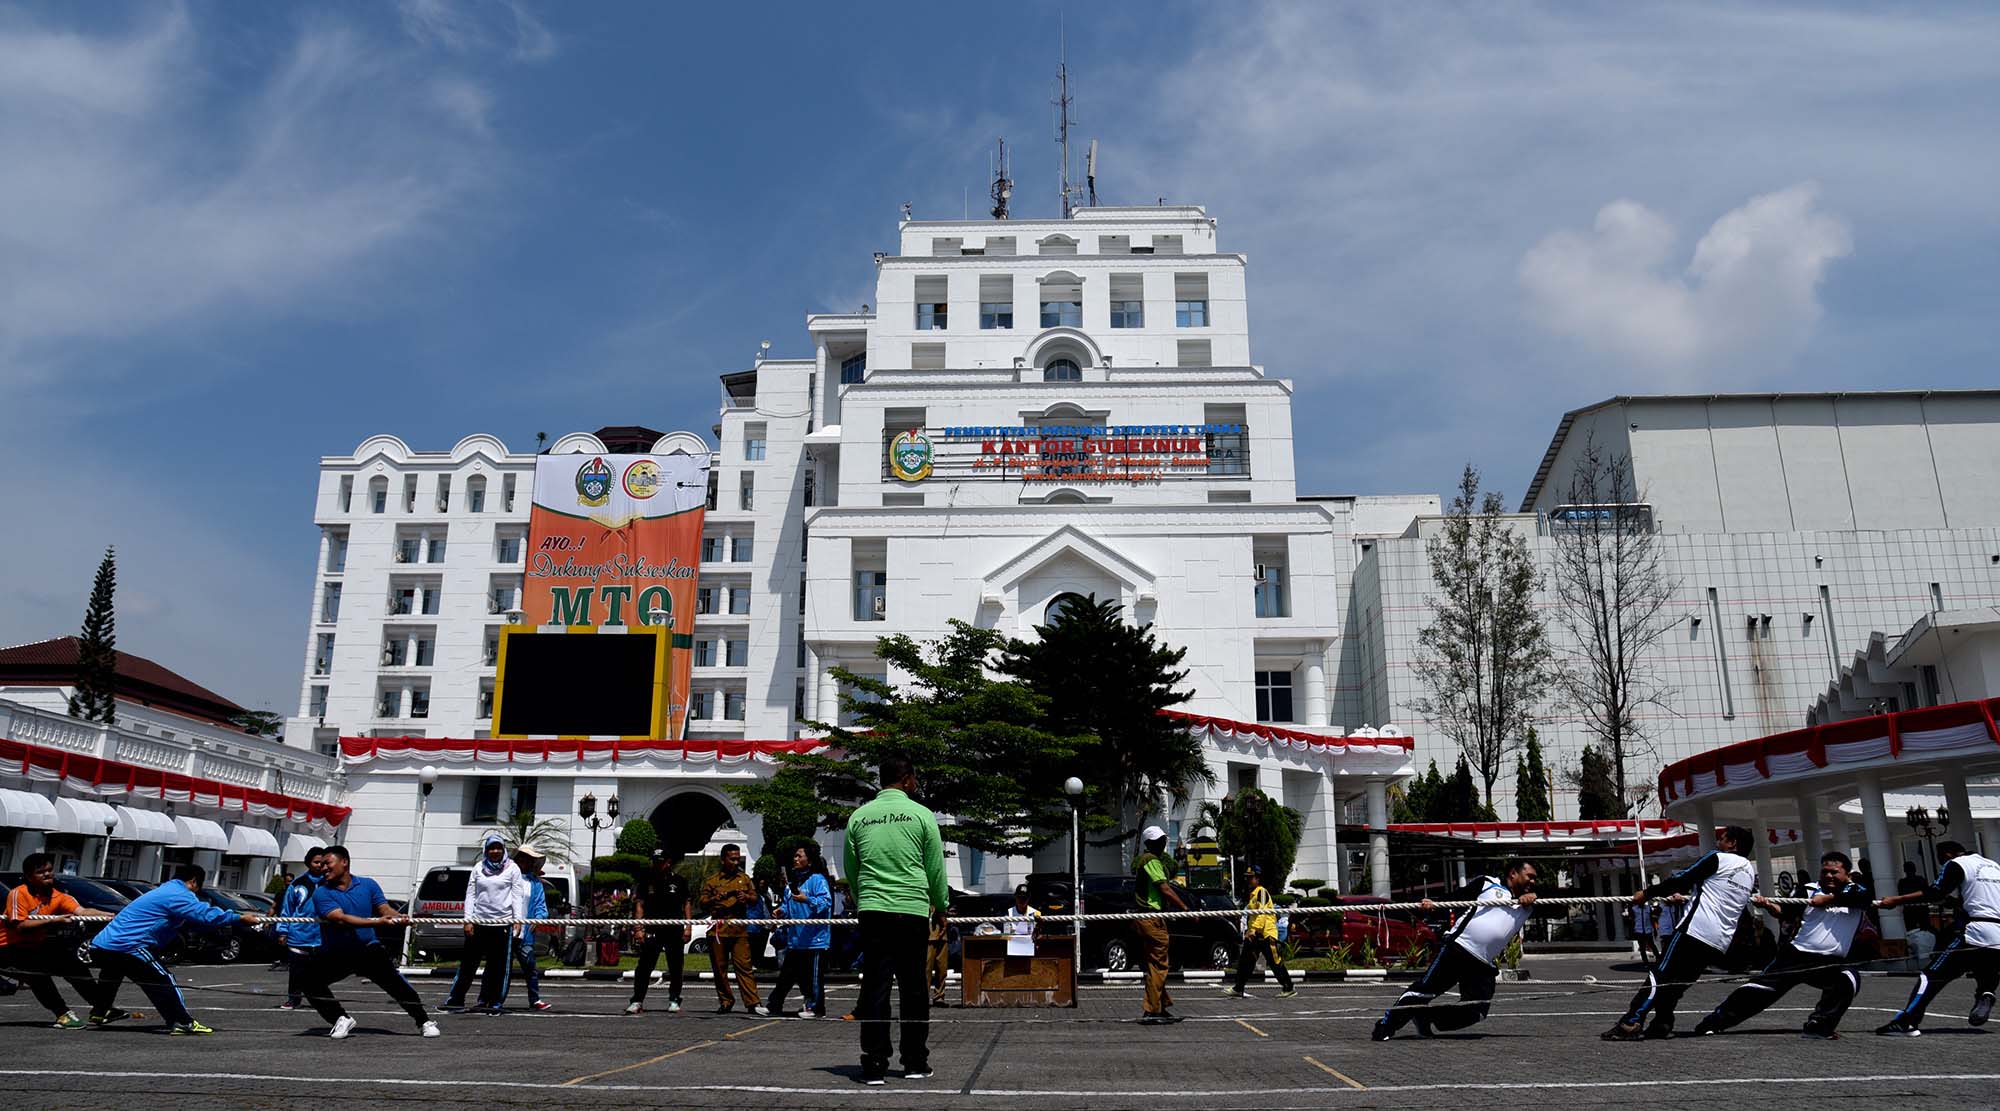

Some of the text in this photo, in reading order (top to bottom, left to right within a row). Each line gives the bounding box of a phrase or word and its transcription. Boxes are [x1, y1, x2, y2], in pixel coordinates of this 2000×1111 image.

[945, 424, 1242, 437] PEMERINTAH PROVINSI SUMATERA UTARA
[981, 439, 1201, 454] KANTOR GUBERNUR
[541, 536, 586, 550] AYO..!
[528, 553, 600, 582] Dukung
[610, 554, 696, 580] Sukseskan
